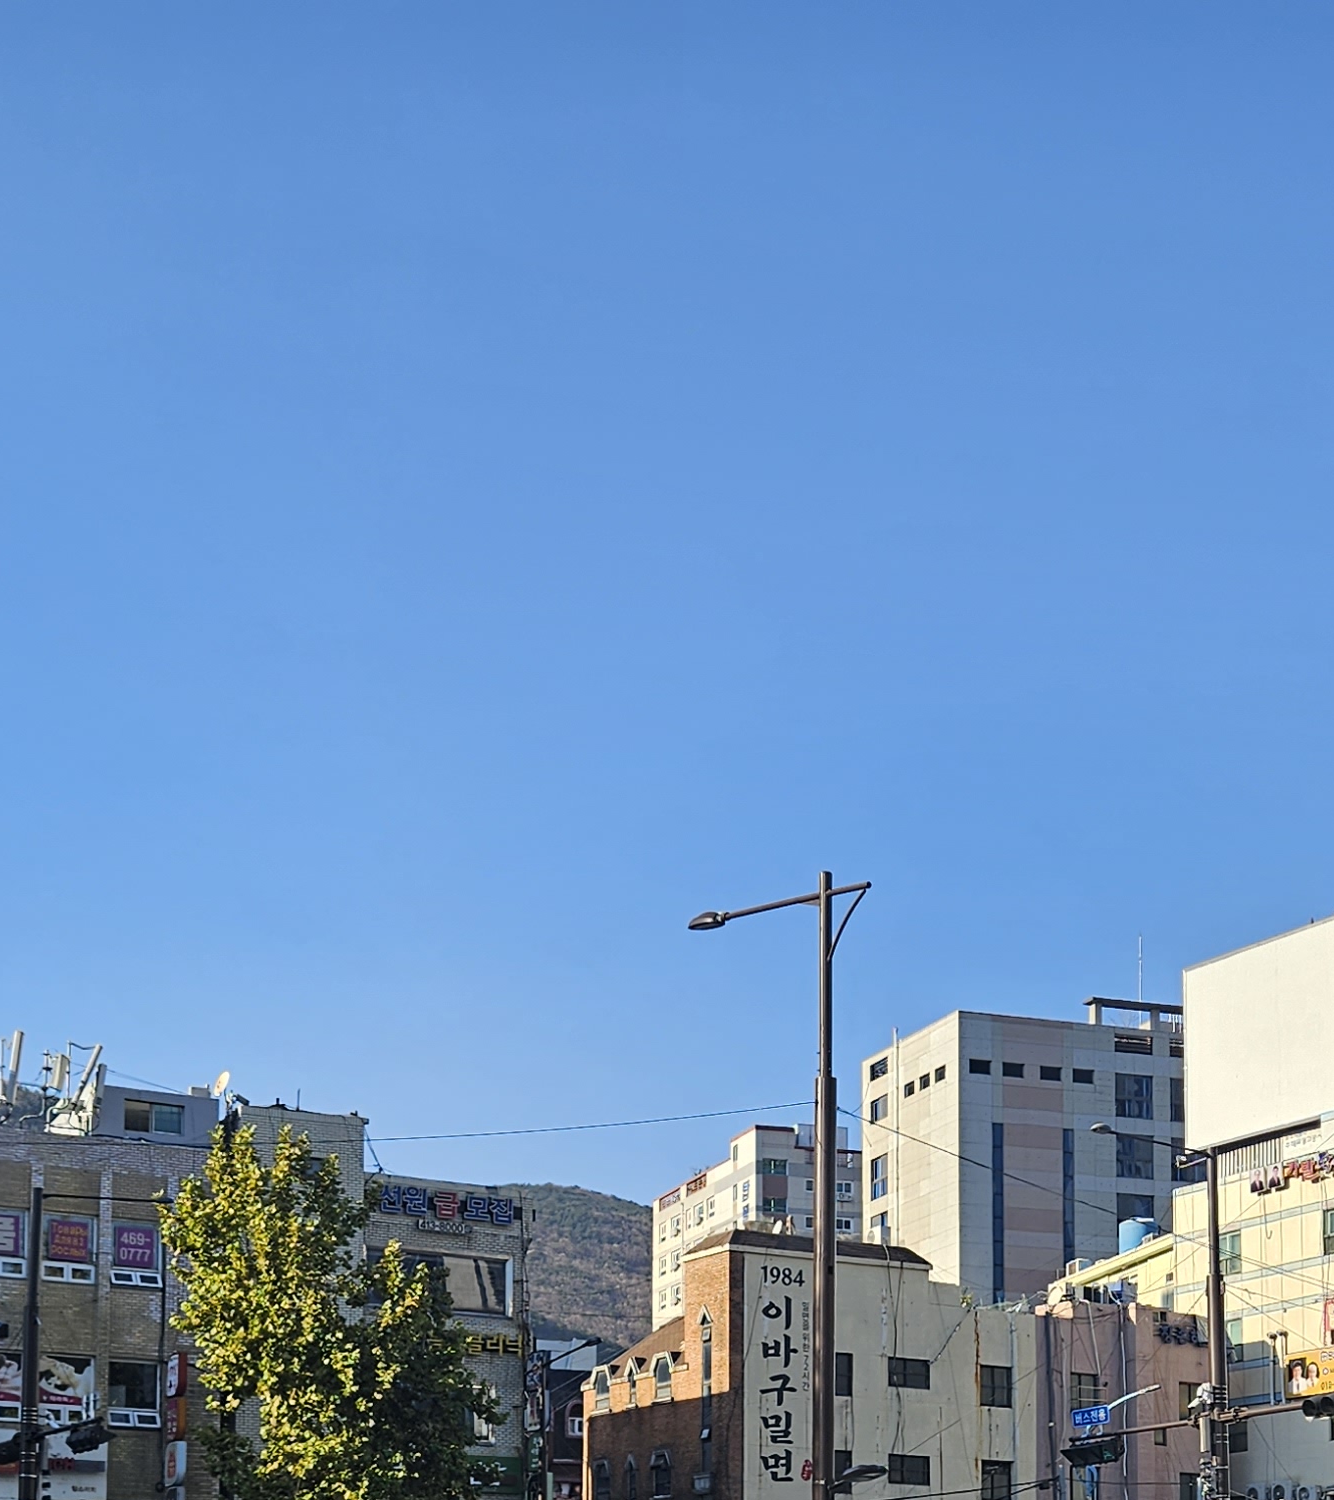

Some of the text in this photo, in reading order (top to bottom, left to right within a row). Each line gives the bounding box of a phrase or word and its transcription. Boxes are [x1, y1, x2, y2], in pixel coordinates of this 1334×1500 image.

[381, 1184, 514, 1226] 선원 급 모집
[120, 1231, 151, 1246] 469-
[119, 1248, 151, 1262] 0777
[760, 1265, 805, 1287] 1984
[759, 1295, 799, 1482] 이바구밀면
[1075, 1411, 1107, 1425] 버스전용
